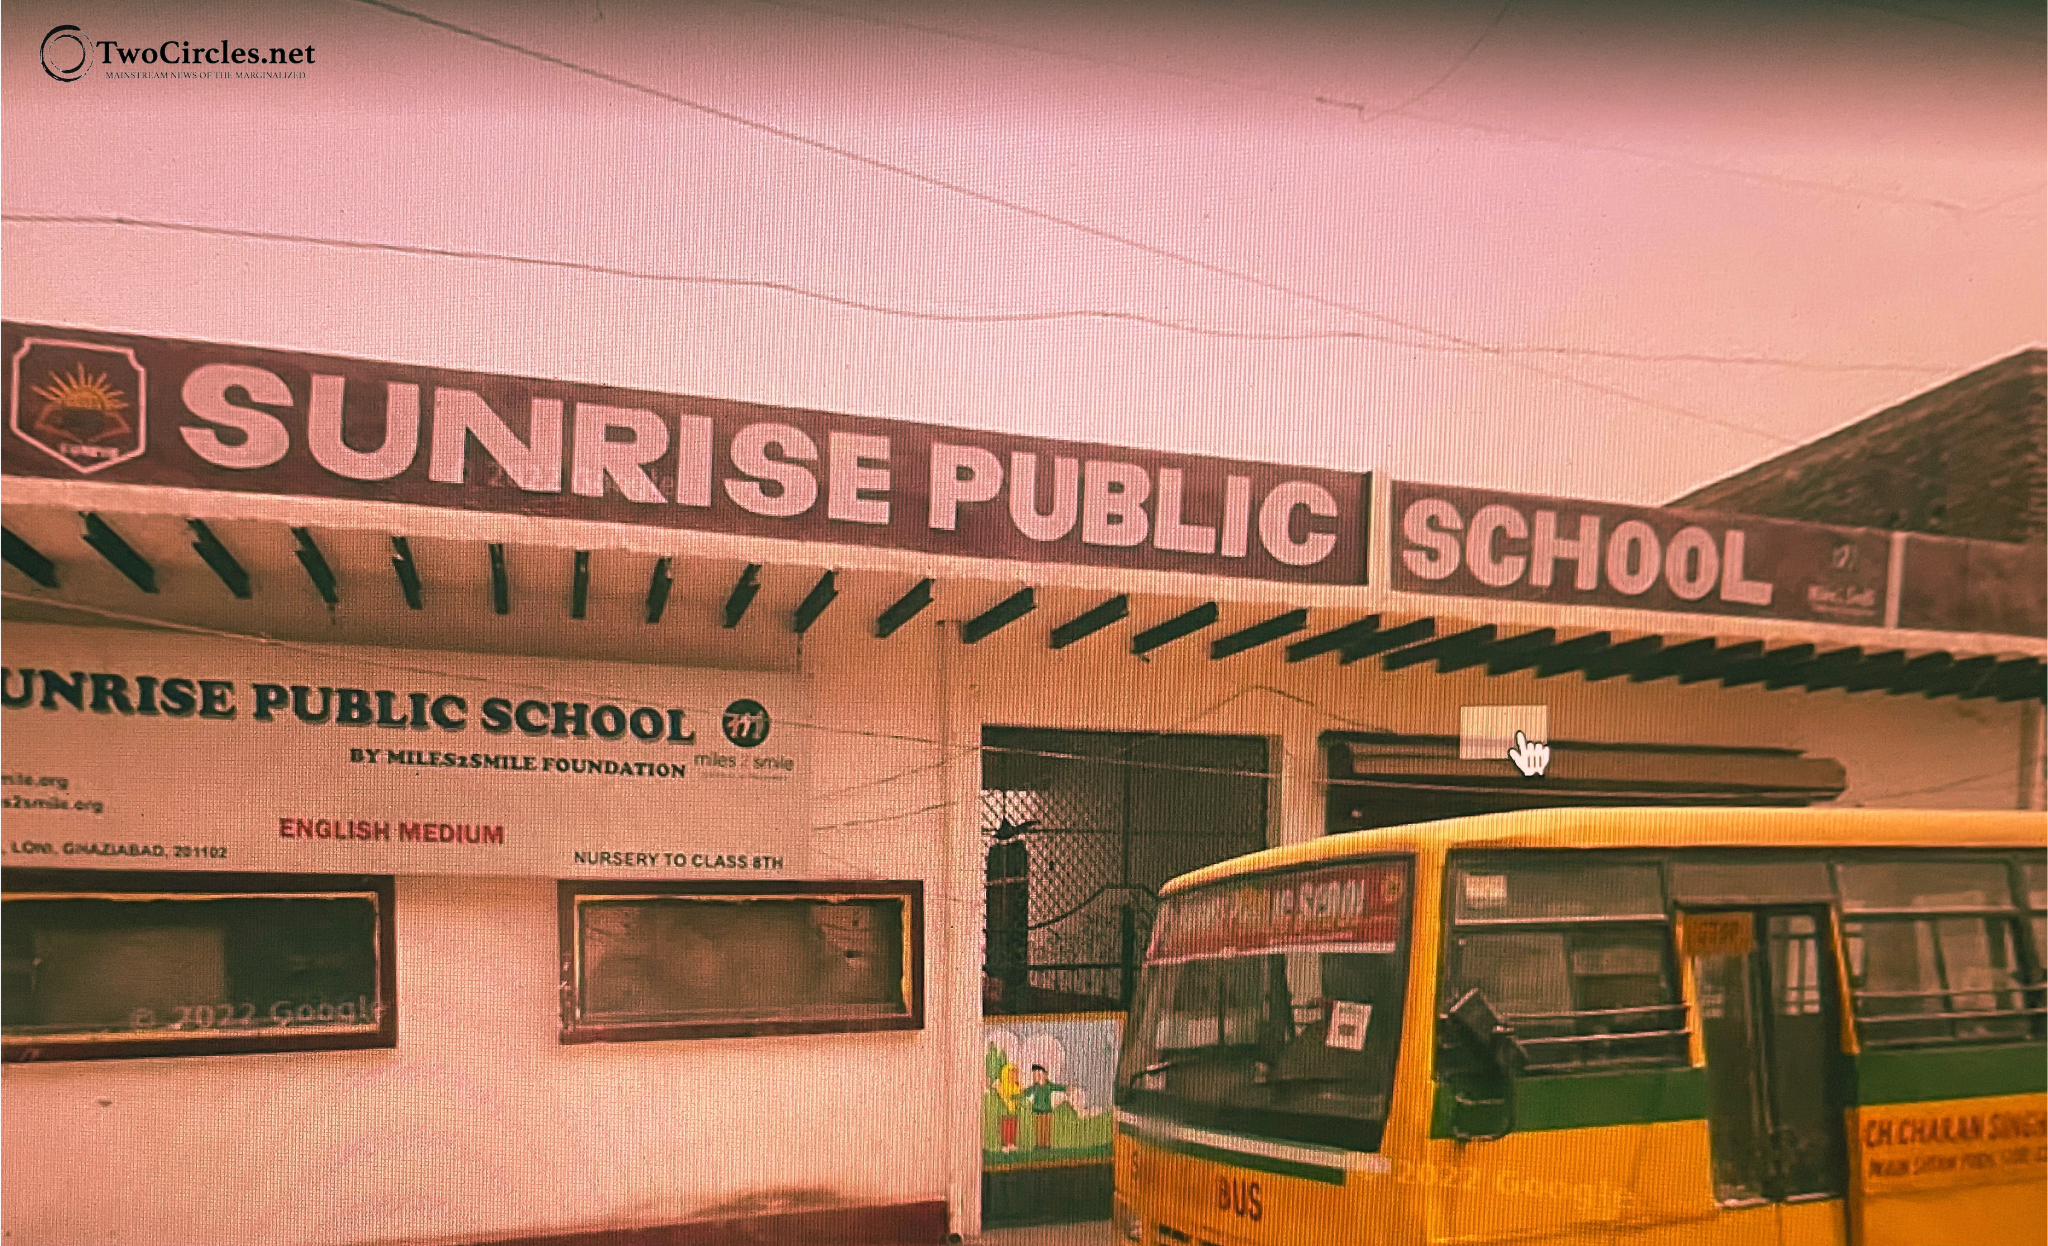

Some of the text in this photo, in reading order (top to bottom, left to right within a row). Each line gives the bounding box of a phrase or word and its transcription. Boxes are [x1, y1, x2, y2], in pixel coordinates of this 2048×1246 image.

[180, 363, 1773, 606] SUNRISE PUBLIC SCHOOL
[251, 684, 469, 731] PUBLIC
[480, 697, 696, 745] SCHOOL
[350, 748, 686, 778] BY MILES2SMILE FOUNDATION
[279, 817, 504, 844] ENGLISH MEDIUM
[574, 851, 784, 869] NURSERY TO CLASS 8TH
[1217, 1175, 1263, 1222] BUS
